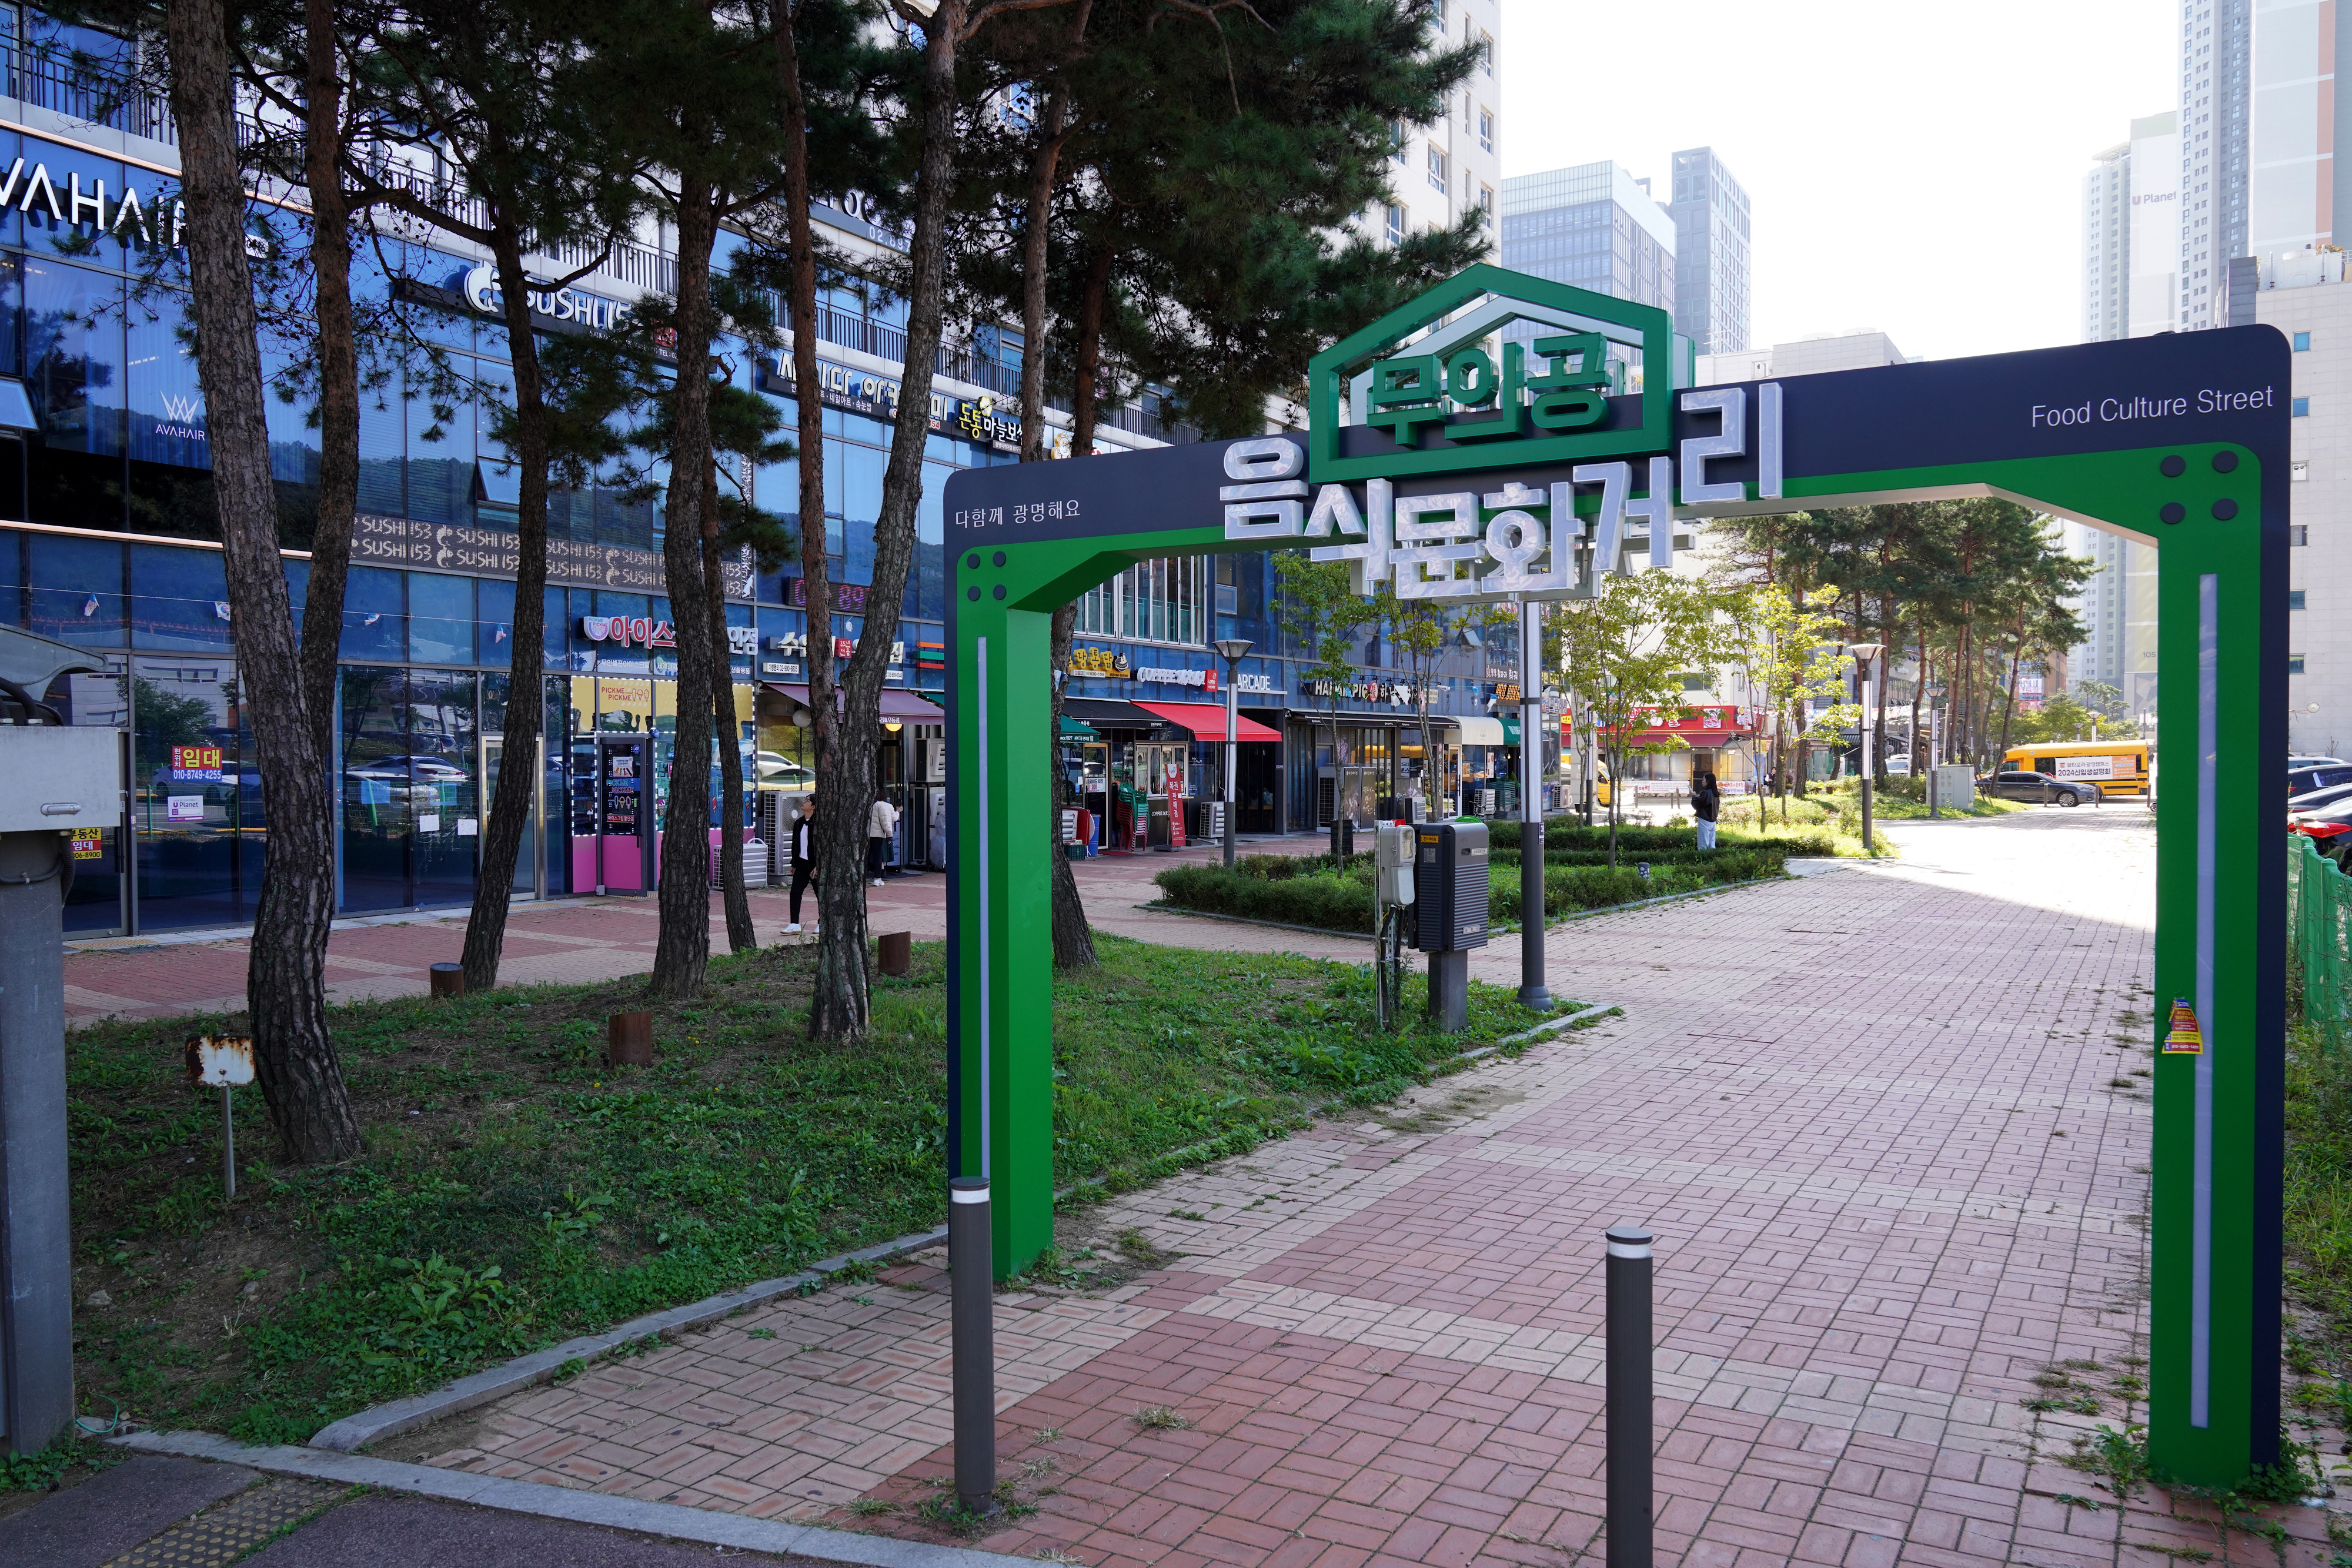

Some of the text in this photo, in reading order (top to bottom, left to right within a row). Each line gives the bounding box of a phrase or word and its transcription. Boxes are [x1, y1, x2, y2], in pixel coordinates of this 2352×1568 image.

[2143, 191, 2176, 204] Planet
[1367, 332, 1612, 447] 무의공
[829, 392, 872, 413] 네일아트 속눈썹
[2032, 385, 2274, 427] Food Culture Street
[156, 424, 205, 441] AVAHAIR
[1220, 382, 1783, 599] 음식문화거리
[955, 499, 1081, 529] 다함께 광명해요
[362, 516, 406, 536] SUSHI
[410, 521, 432, 540] 153
[456, 527, 498, 547] SUSHI
[362, 538, 406, 558] SUSHI
[410, 544, 432, 561] 153
[456, 549, 498, 569] SUSHI
[840, 640, 851, 648] 35년
[1068, 647, 1114, 671] 랑통닭
[731, 667, 750, 675] 생활용품
[1137, 667, 1177, 683] COFFEE
[1237, 674, 1271, 691] ARCADE
[183, 748, 220, 768] 임대
[173, 769, 221, 780] 010-8749-4255
[2058, 768, 2111, 777] 2024신입생설명회
[72, 841, 93, 851] 임대
